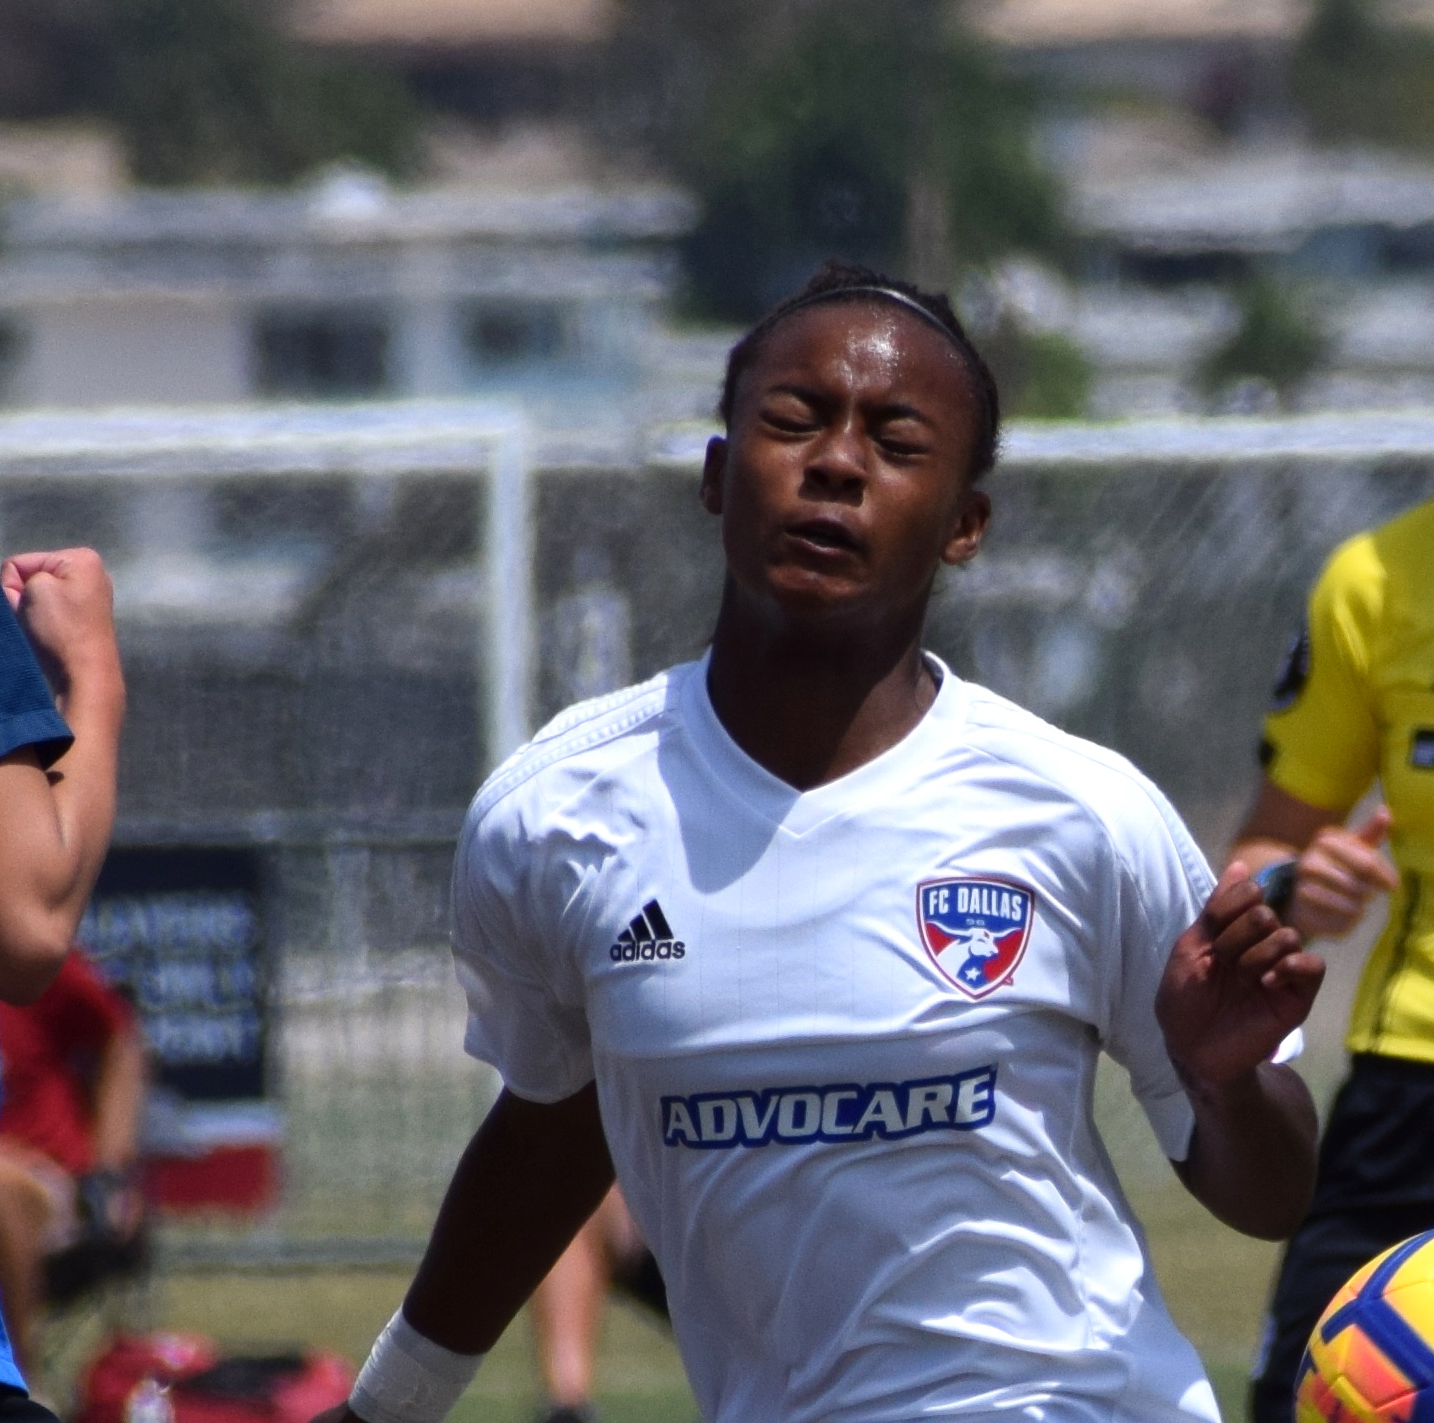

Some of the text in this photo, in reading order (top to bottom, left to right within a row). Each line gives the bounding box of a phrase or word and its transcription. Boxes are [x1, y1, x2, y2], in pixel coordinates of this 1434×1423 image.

[929, 886, 1023, 921] FC DALLAS
[609, 940, 686, 961] adidas
[665, 1070, 993, 1143] ADVOCARE
